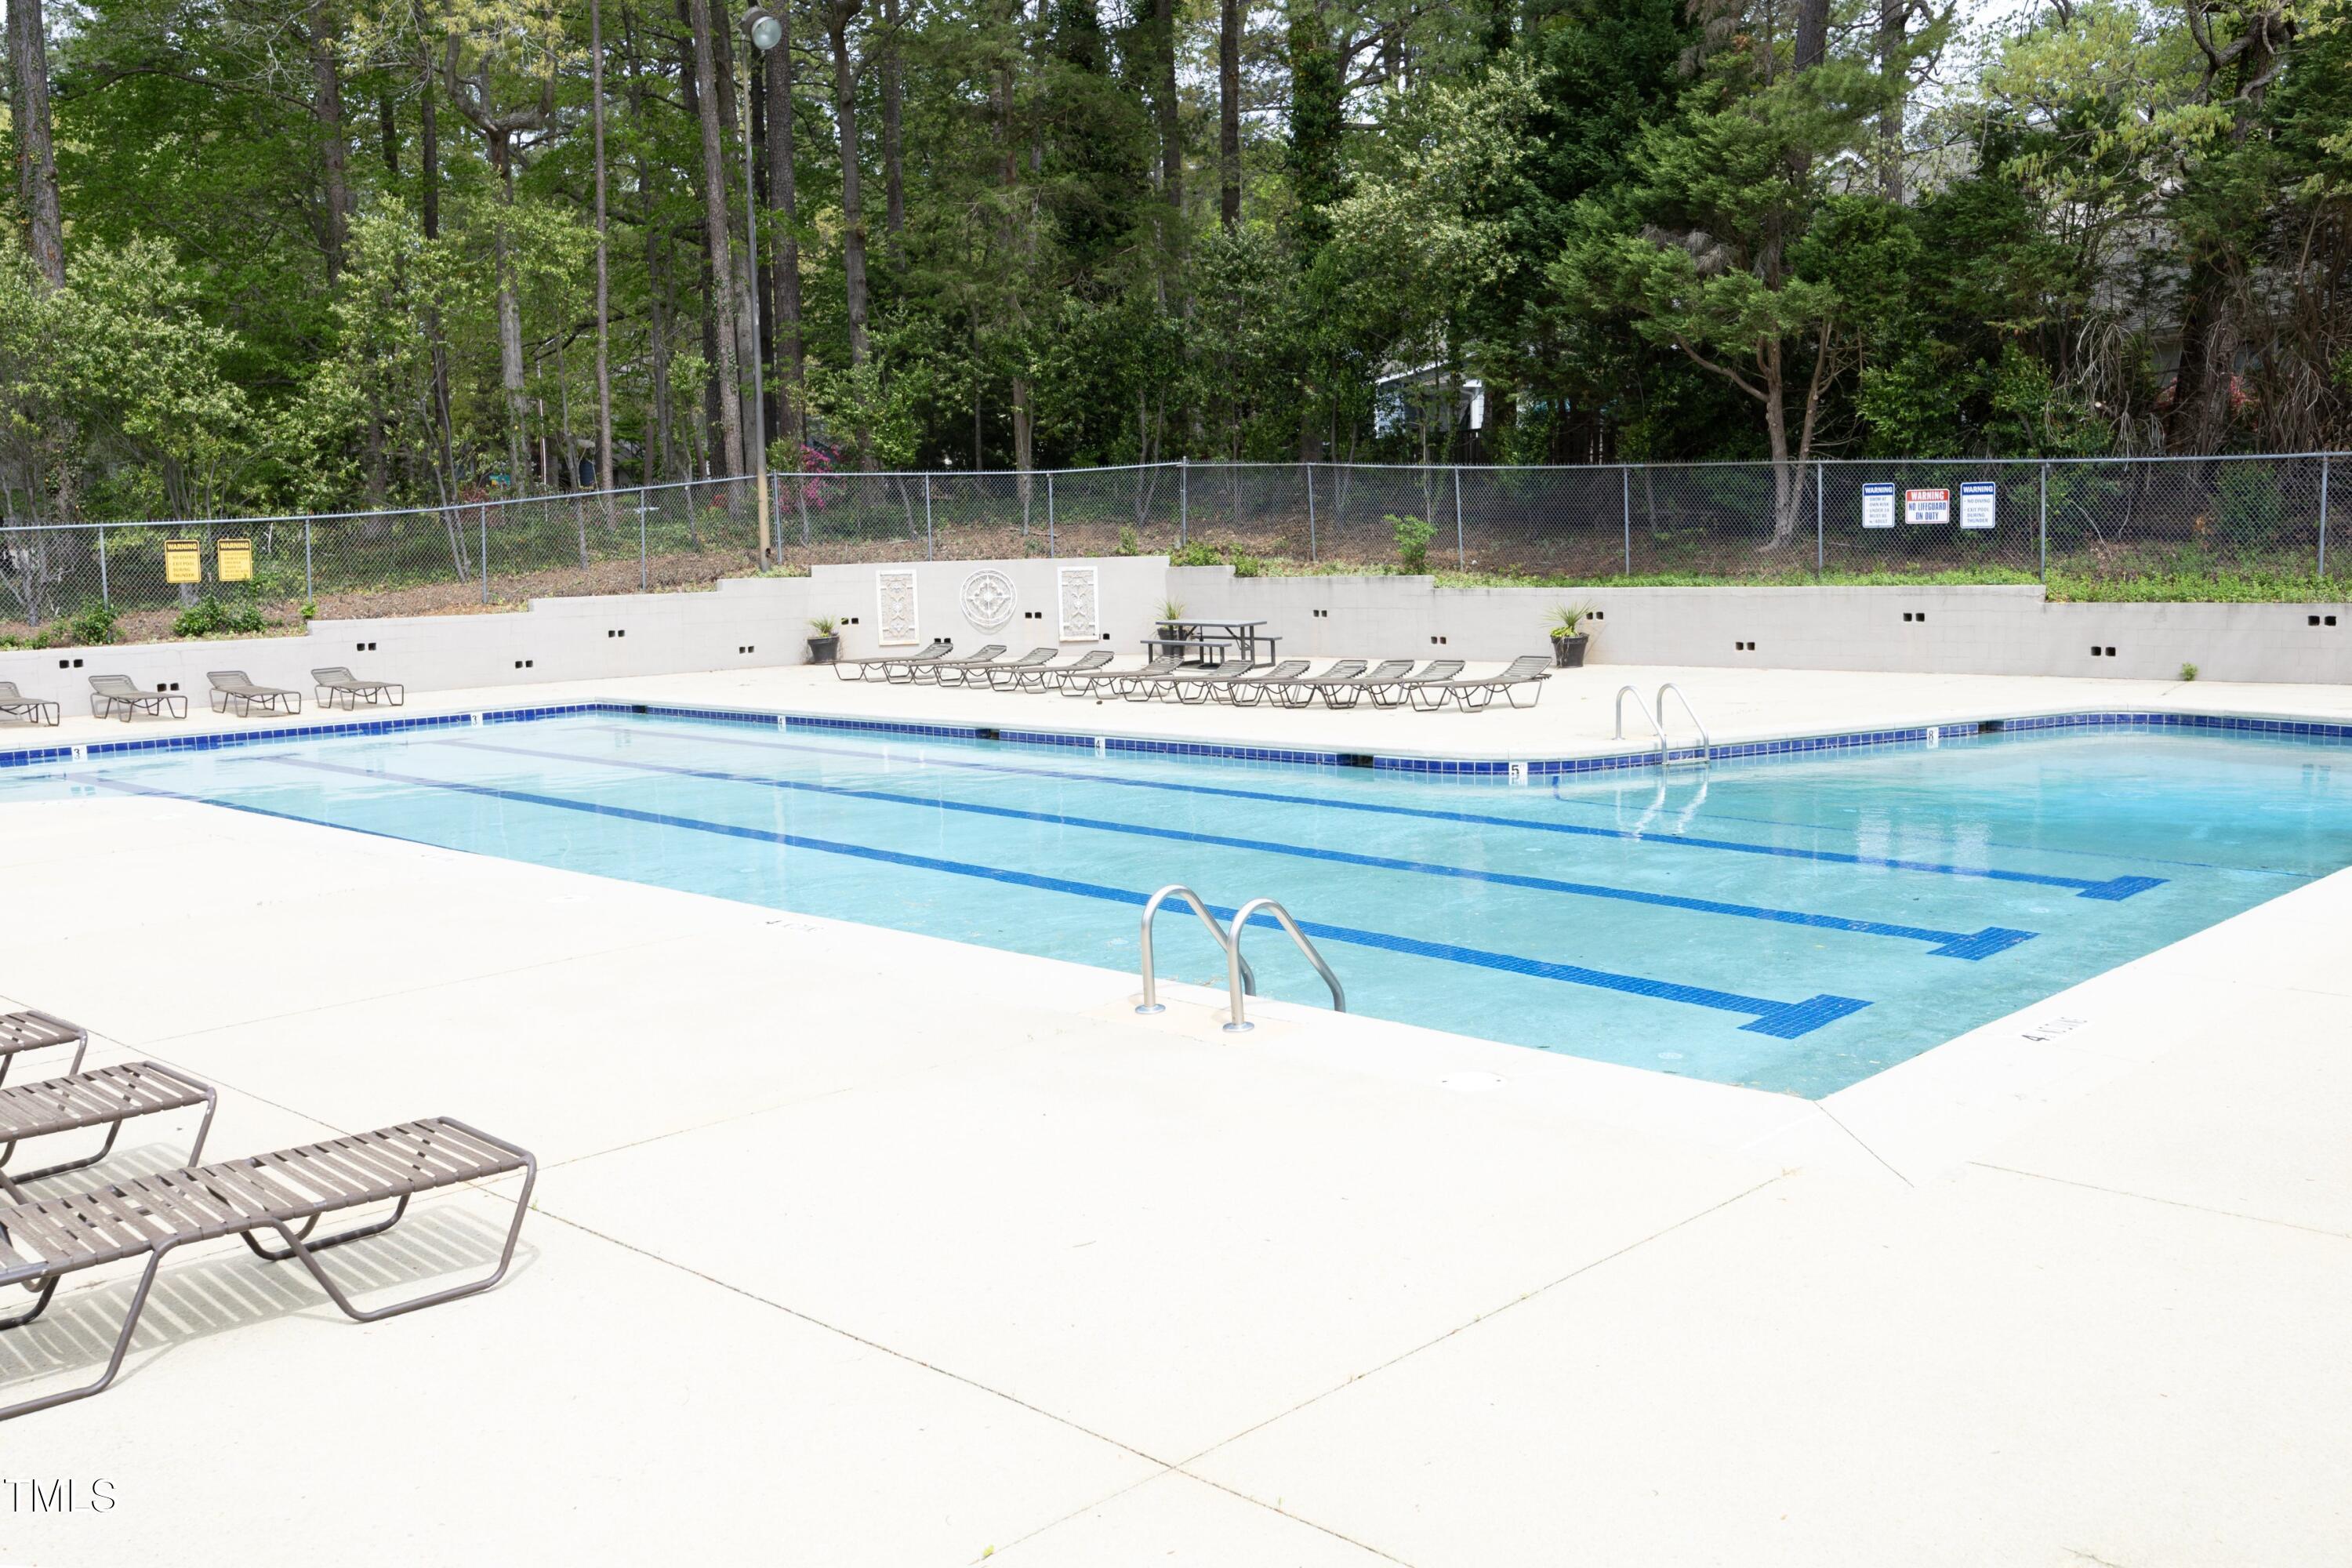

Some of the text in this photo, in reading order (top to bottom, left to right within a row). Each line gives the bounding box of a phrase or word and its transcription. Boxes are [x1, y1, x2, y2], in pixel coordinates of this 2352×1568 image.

[1911, 491, 1944, 500] WARNING
[1918, 502, 1946, 510] LIFEGUARD
[1512, 764, 1519, 775] 5
